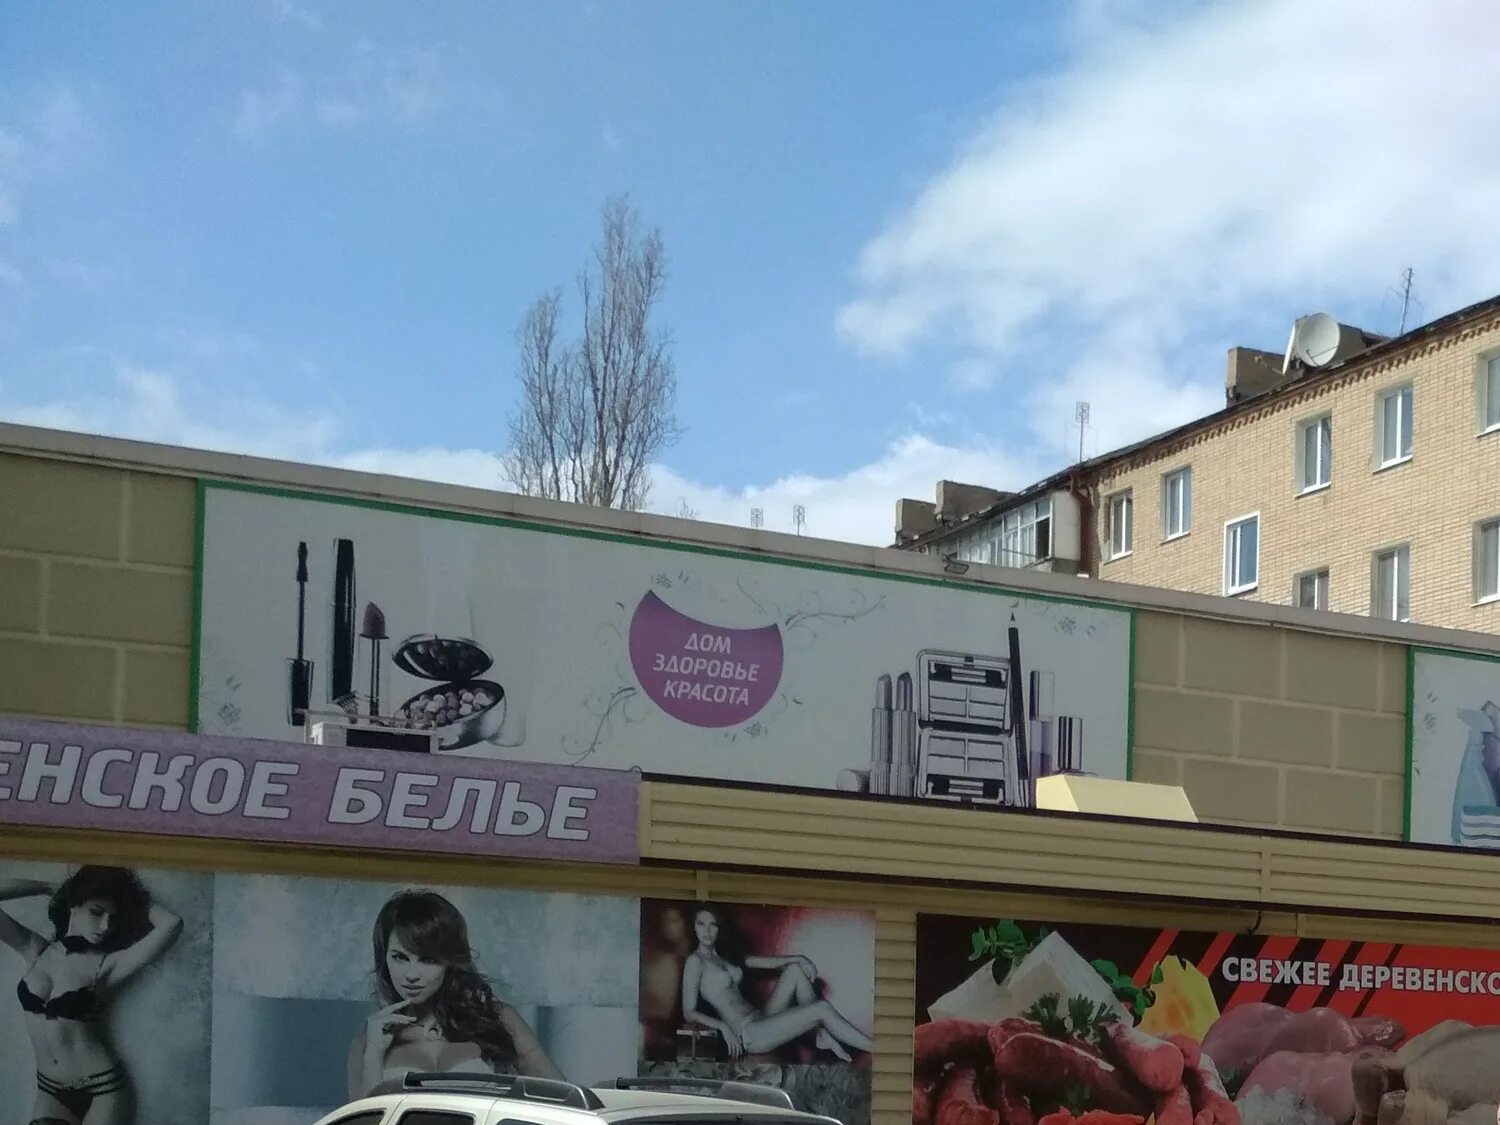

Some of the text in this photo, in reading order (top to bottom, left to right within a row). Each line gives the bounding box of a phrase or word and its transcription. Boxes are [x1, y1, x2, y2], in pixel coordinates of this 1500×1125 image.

[684, 632, 732, 654] ДОМ
[652, 653, 761, 682] ЗДОРОВЬЕ
[663, 680, 750, 706] КРАСОТА
[326, 766, 598, 841] БЕЛЬЕ
[1222, 956, 1331, 986] СВЕЖЕЕ
